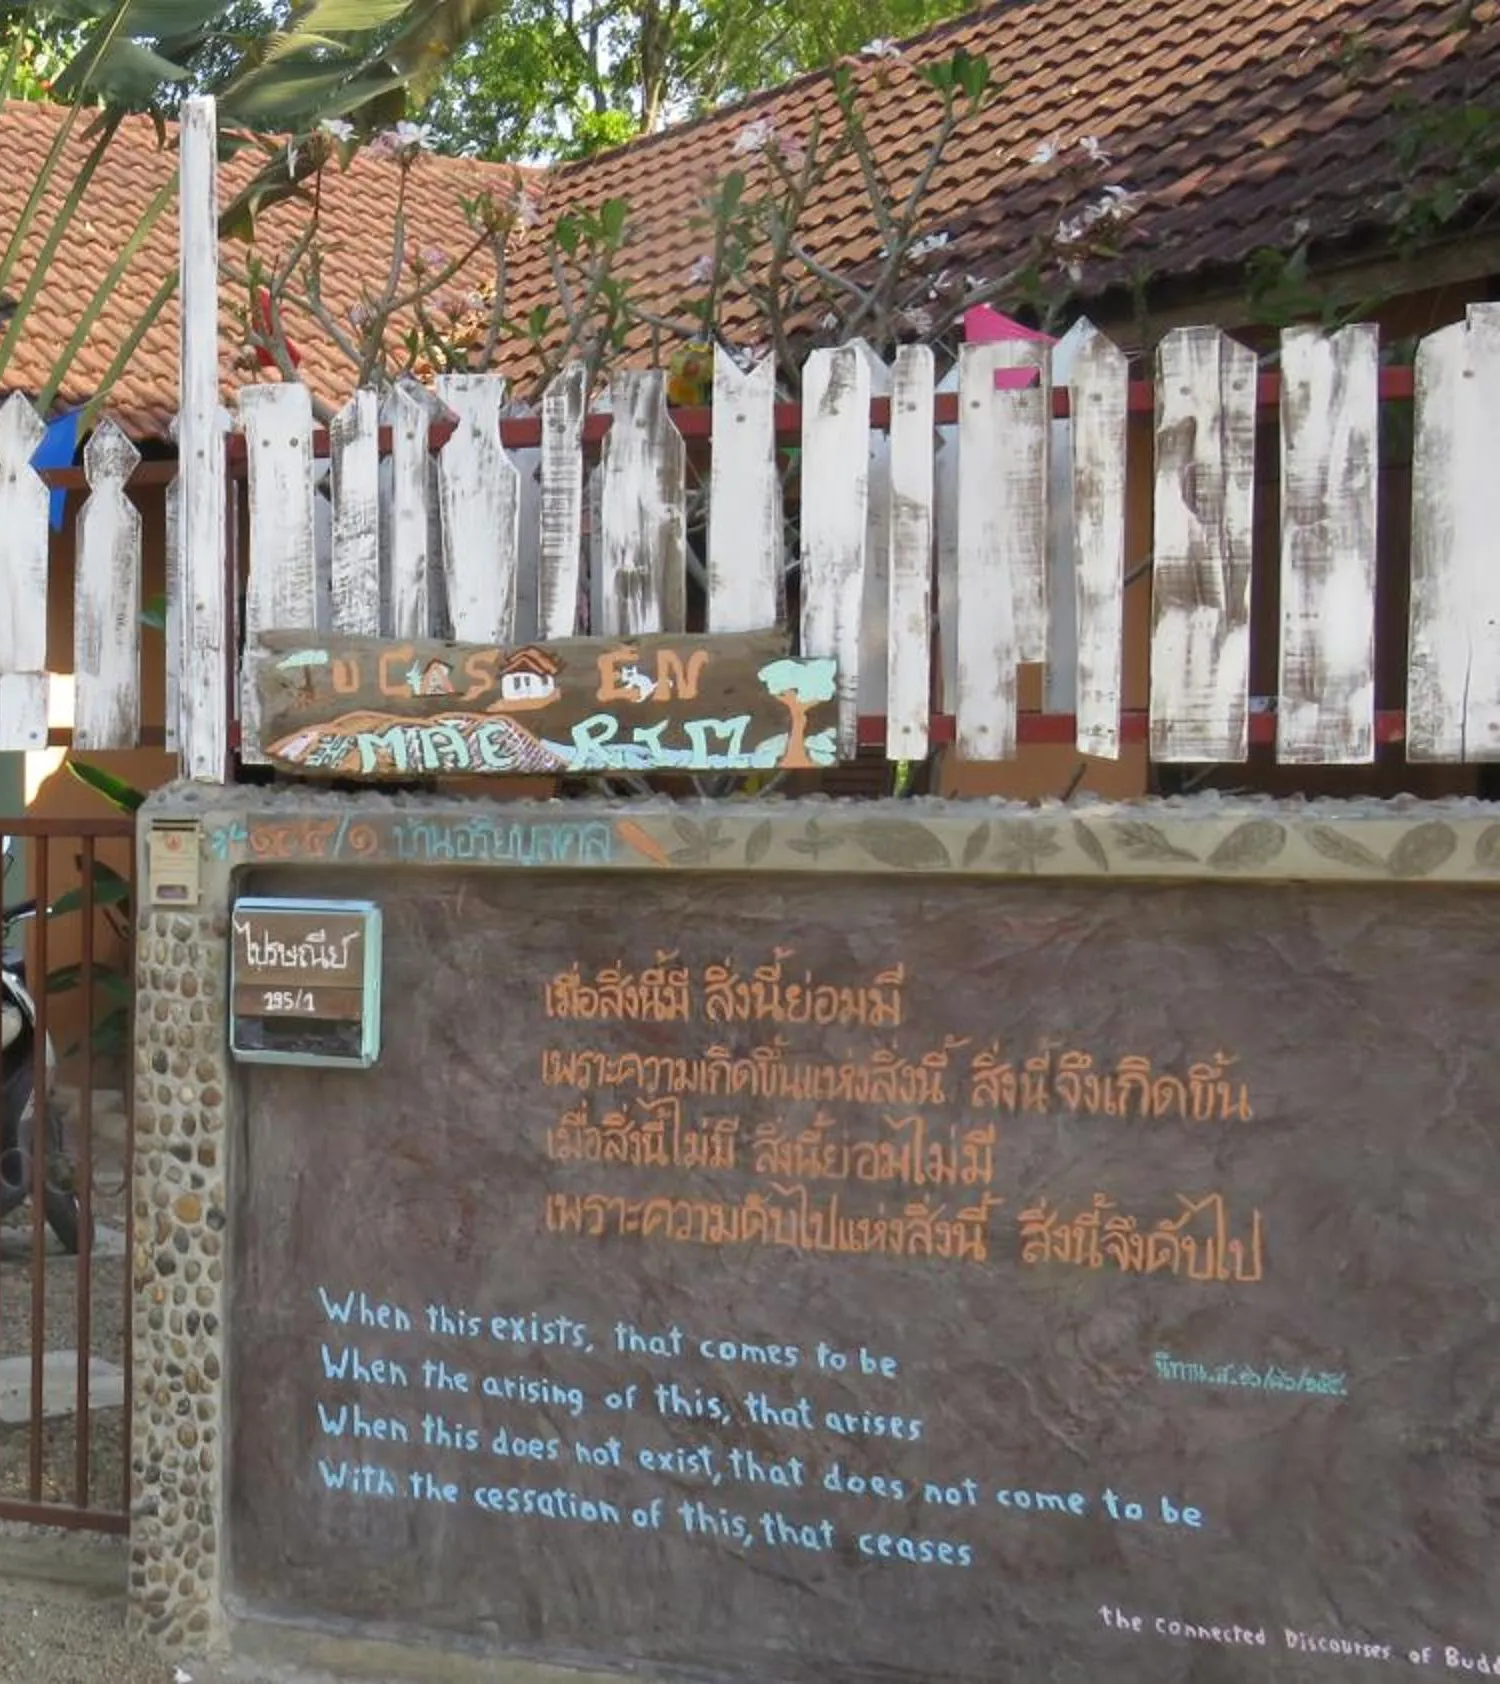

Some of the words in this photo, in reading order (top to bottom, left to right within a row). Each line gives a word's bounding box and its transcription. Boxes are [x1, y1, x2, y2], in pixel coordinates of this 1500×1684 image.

[597, 648, 710, 703] EN
[357, 718, 521, 773] MAE
[567, 713, 752, 772] RIM
[233, 917, 360, 971] ไปรษณีย์
[318, 1287, 411, 1332] When
[426, 1304, 481, 1337] this
[491, 1312, 594, 1353] exists,
[615, 1321, 683, 1357] that
[700, 1337, 799, 1366] comes
[816, 1341, 847, 1372] to
[860, 1347, 898, 1379] be
[320, 1343, 408, 1388] When
[422, 1359, 469, 1393] the
[483, 1374, 584, 1417] arising
[605, 1384, 638, 1411] of
[654, 1383, 732, 1426] this,
[744, 1391, 813, 1430] that
[825, 1409, 923, 1441] arises
[317, 1401, 409, 1443] When
[421, 1412, 480, 1452] this
[492, 1427, 560, 1462] does
[575, 1436, 622, 1468] not
[638, 1446, 723, 1487] exist,
[728, 1447, 804, 1488] that
[823, 1463, 904, 1500] does
[924, 1477, 978, 1507] not
[997, 1487, 1086, 1517] come
[1101, 1487, 1143, 1521] to
[1161, 1496, 1203, 1529] be
[318, 1458, 396, 1498] With
[408, 1470, 459, 1504] the
[473, 1485, 622, 1526] cessation
[631, 1498, 663, 1529] of
[677, 1499, 755, 1548] this,
[758, 1510, 835, 1551] that
[859, 1530, 974, 1568] ceases
[1099, 1604, 1143, 1634] the
[1155, 1615, 1267, 1647] connected
[1284, 1627, 1392, 1662] Discourses
[1408, 1645, 1432, 1666] of
